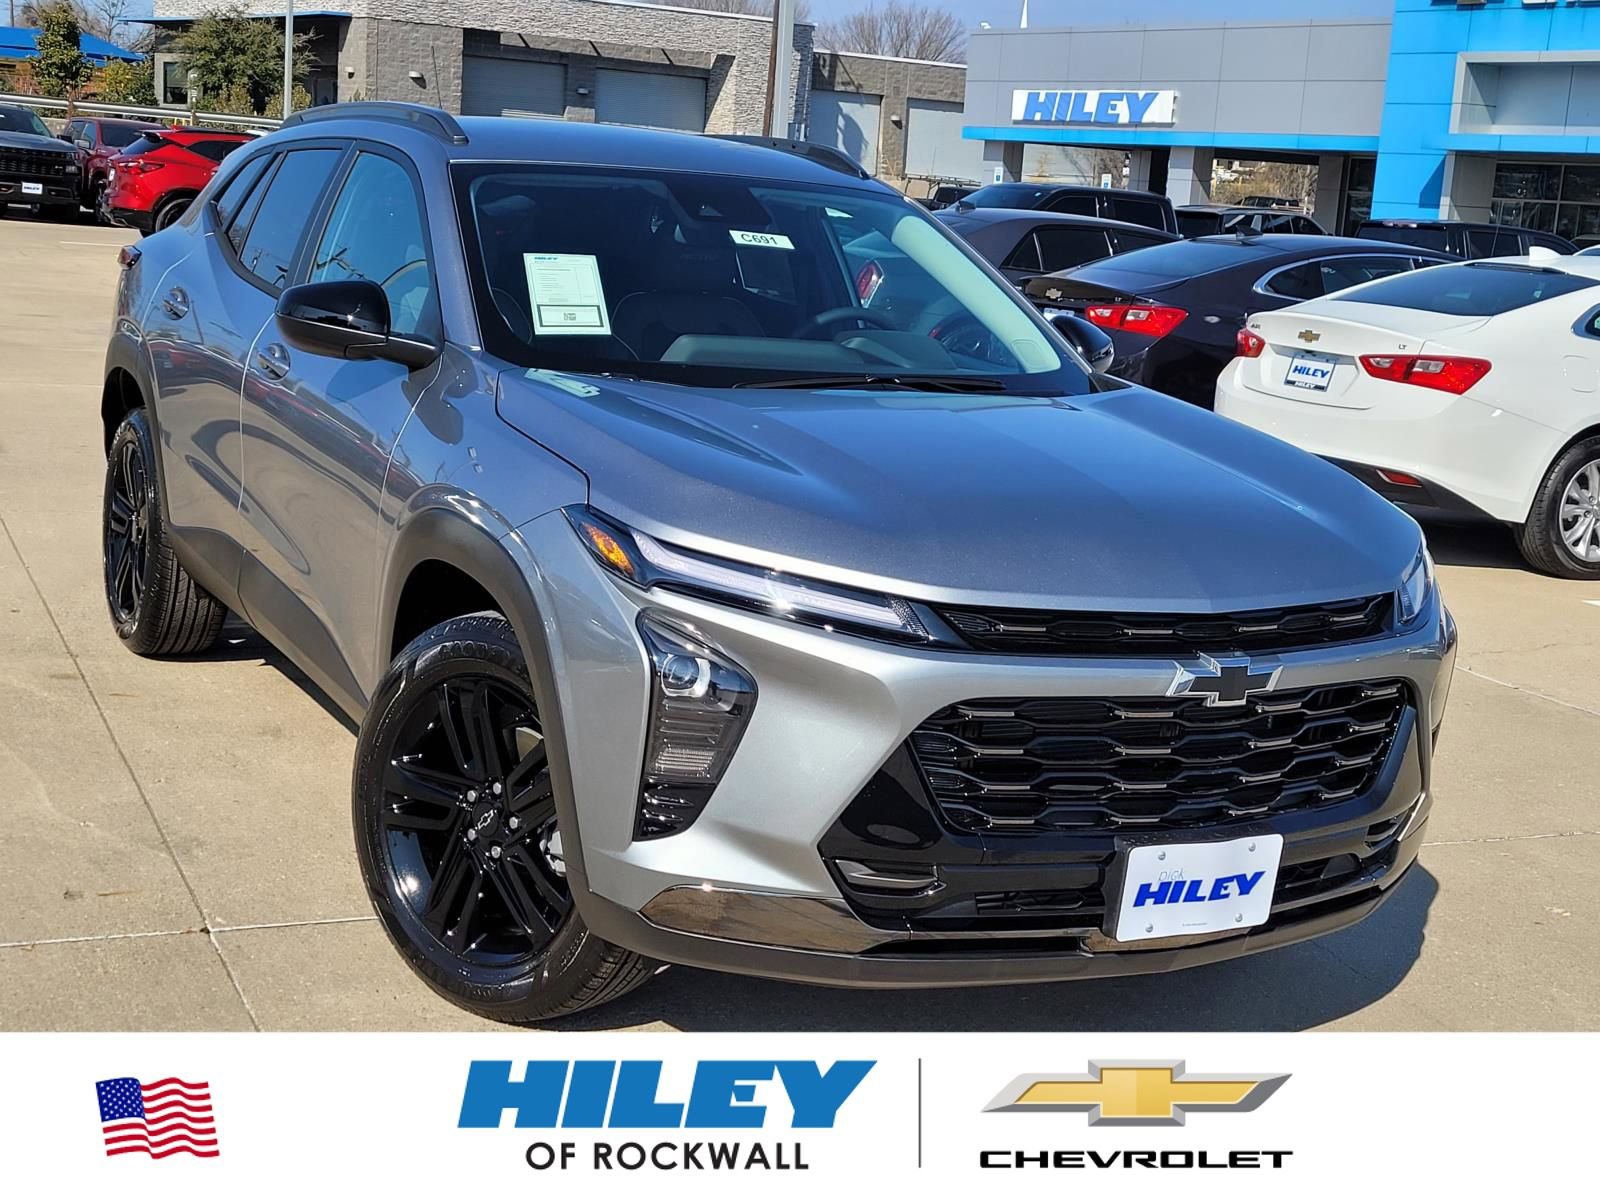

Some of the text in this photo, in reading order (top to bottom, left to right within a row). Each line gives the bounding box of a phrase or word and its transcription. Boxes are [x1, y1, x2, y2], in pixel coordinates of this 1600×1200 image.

[1023, 92, 1159, 124] HILEY
[741, 233, 778, 245] C691
[1292, 365, 1330, 378] HILEY
[1133, 871, 1266, 907] HILEY
